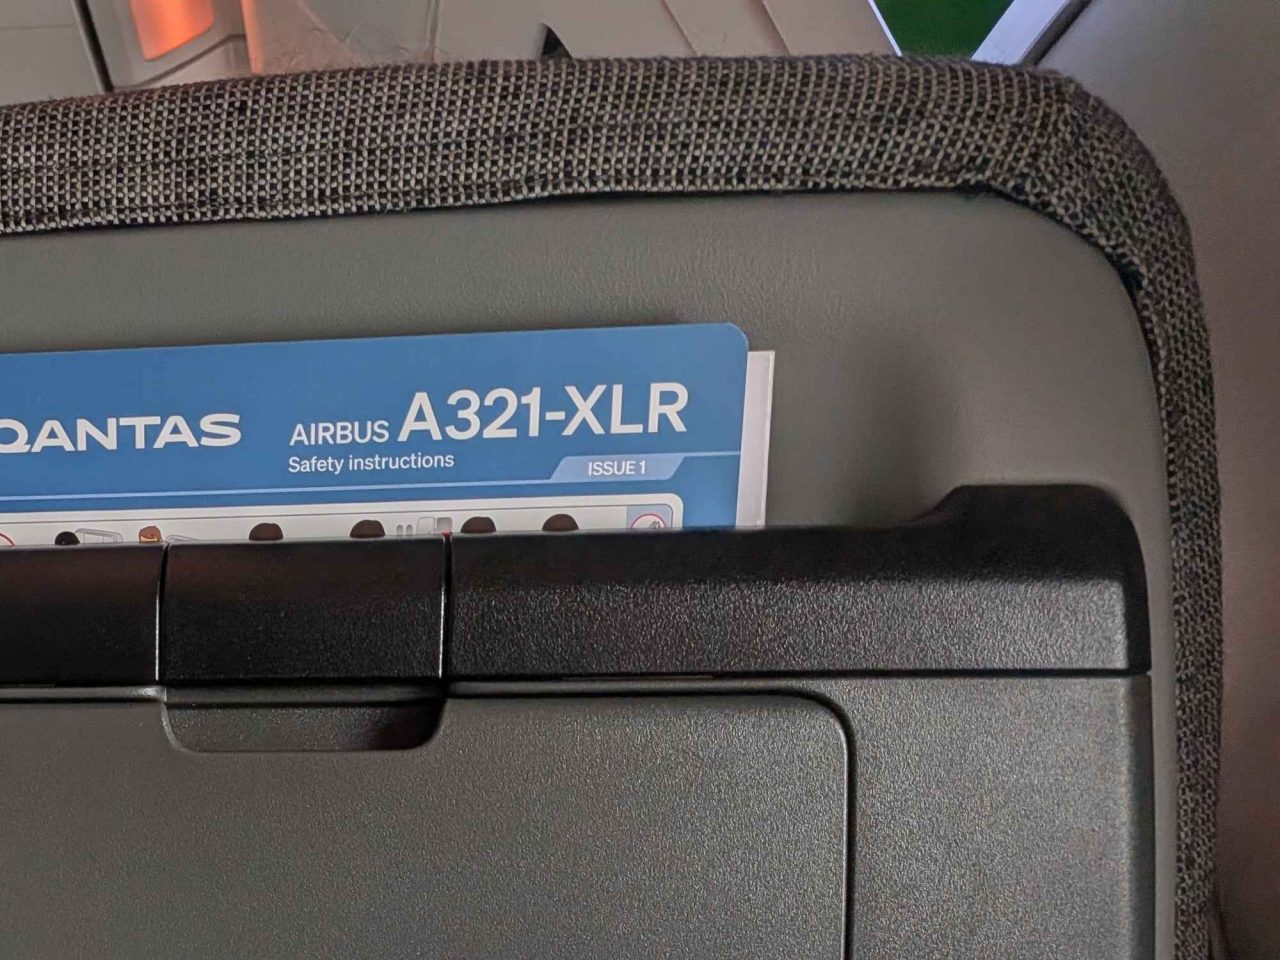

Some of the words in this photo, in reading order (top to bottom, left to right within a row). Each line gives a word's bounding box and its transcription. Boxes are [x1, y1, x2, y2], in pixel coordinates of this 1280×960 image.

[289, 420, 389, 446] AIRBUS
[397, 382, 689, 442] A321-XLR
[288, 455, 343, 477] Safety
[349, 452, 455, 472] instructions
[588, 461, 636, 476] ISSUE
[639, 460, 646, 475] 1
